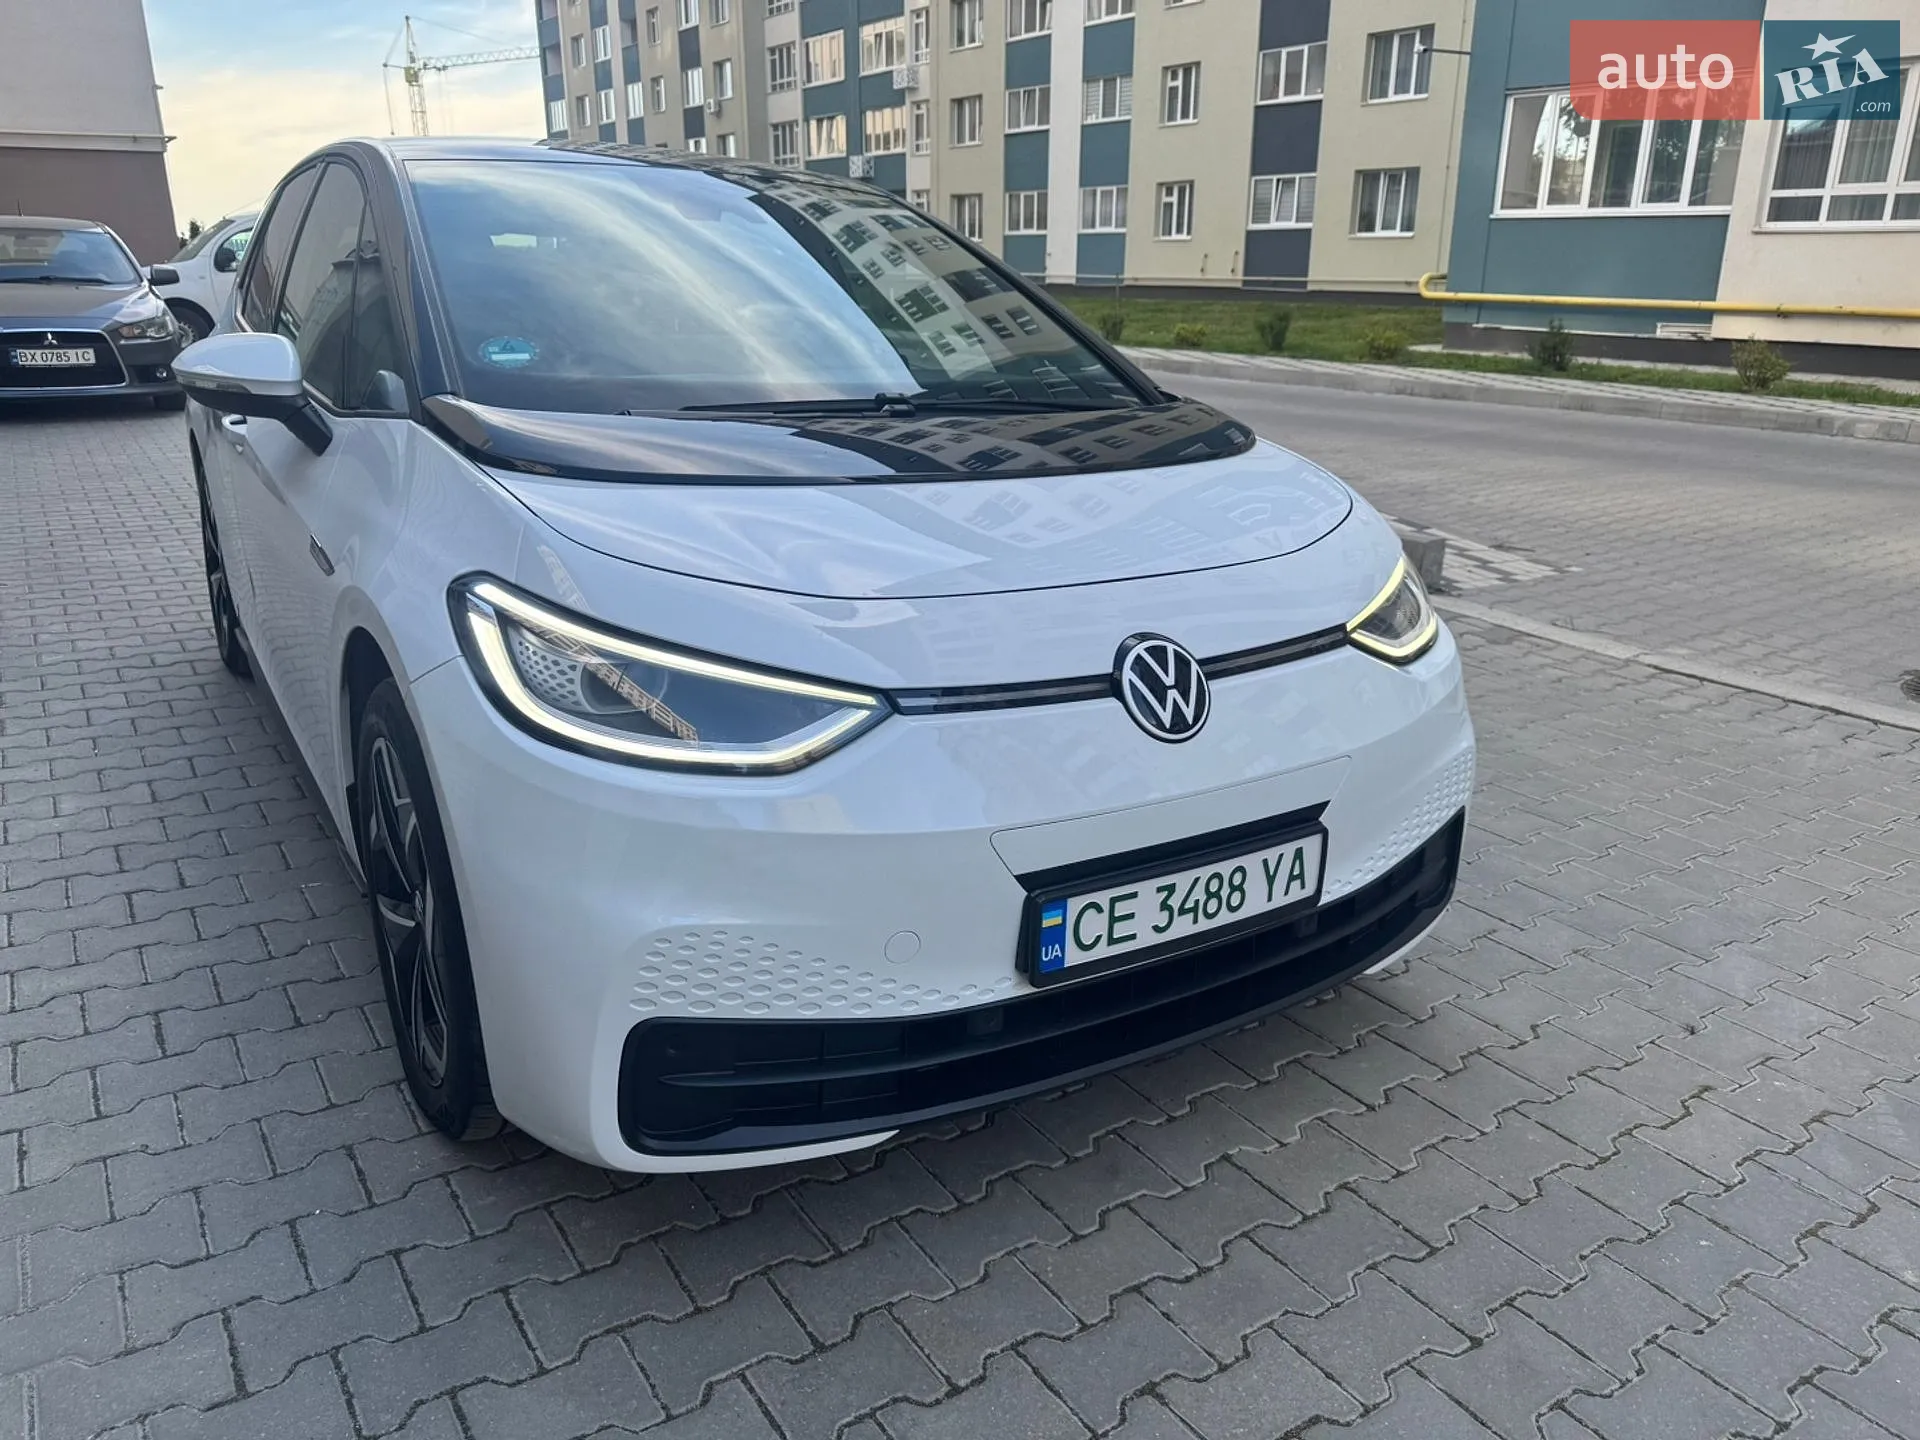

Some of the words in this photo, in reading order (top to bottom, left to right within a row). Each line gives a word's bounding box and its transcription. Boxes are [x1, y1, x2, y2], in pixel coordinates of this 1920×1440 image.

[19, 351, 38, 363] BX
[41, 351, 71, 363] 0785
[1073, 891, 1140, 951] CE
[1151, 865, 1248, 934] 3488
[1262, 846, 1306, 902] YA
[1041, 943, 1063, 961] UA
